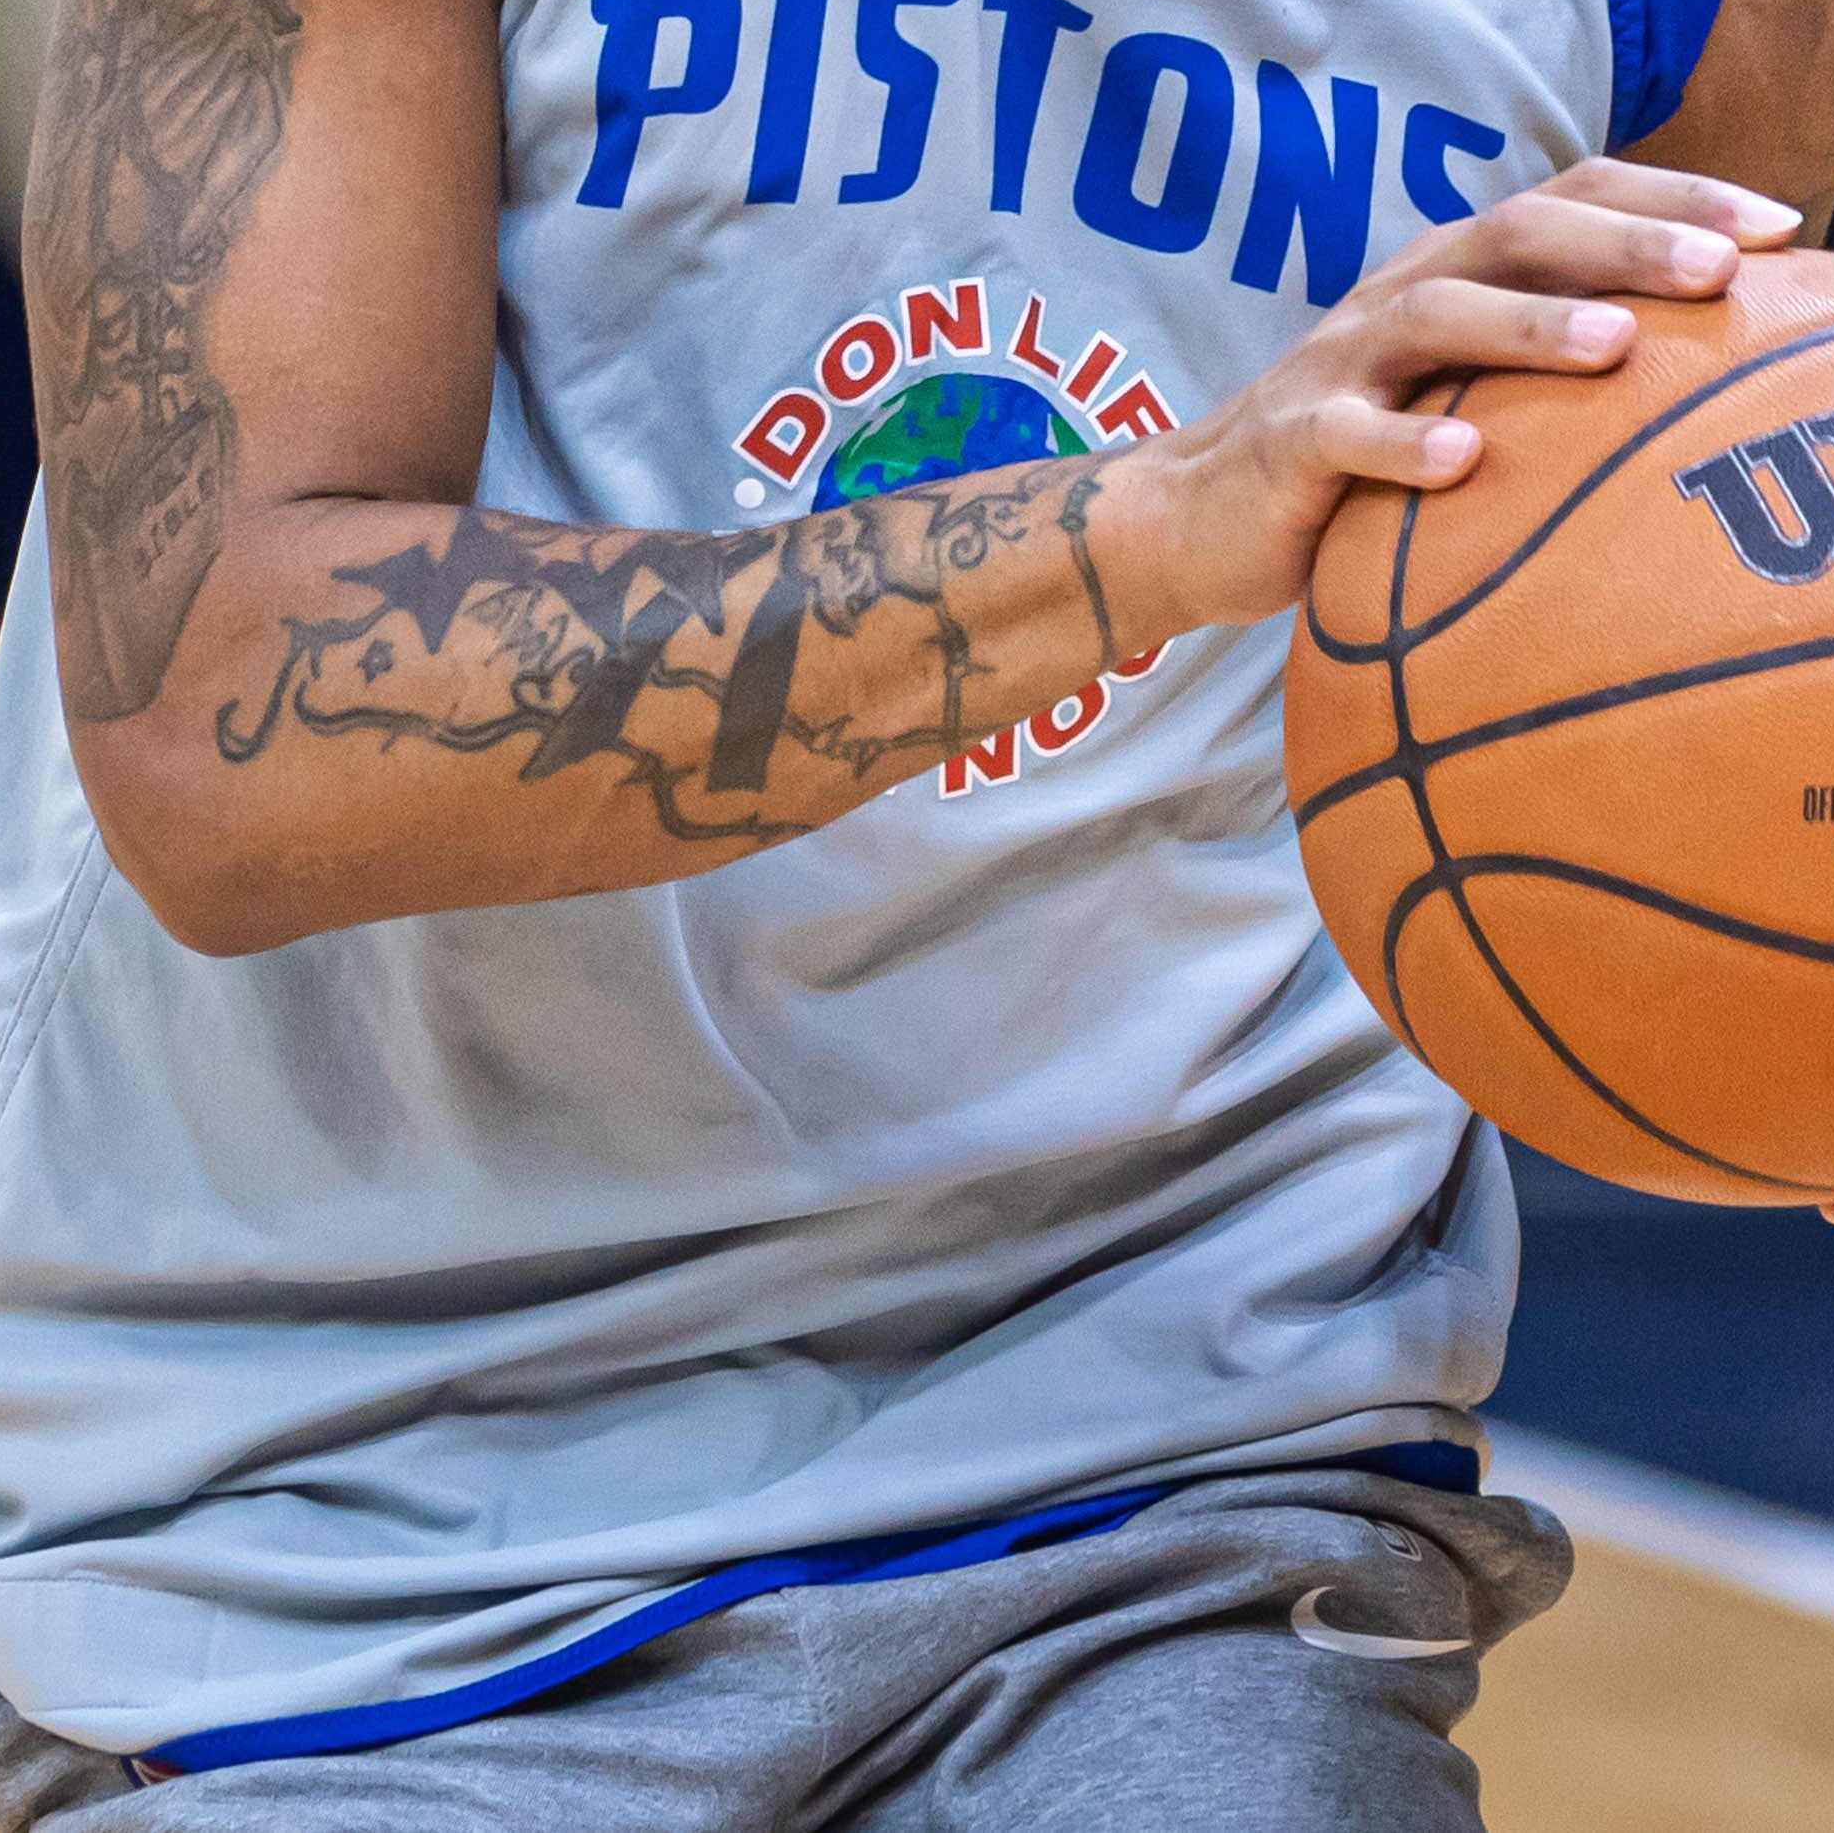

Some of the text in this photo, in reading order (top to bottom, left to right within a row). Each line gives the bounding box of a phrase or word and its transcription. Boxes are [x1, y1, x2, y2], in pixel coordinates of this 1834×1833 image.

[731, 276, 1183, 490] DON LIF
[937, 636, 1175, 800] NO
